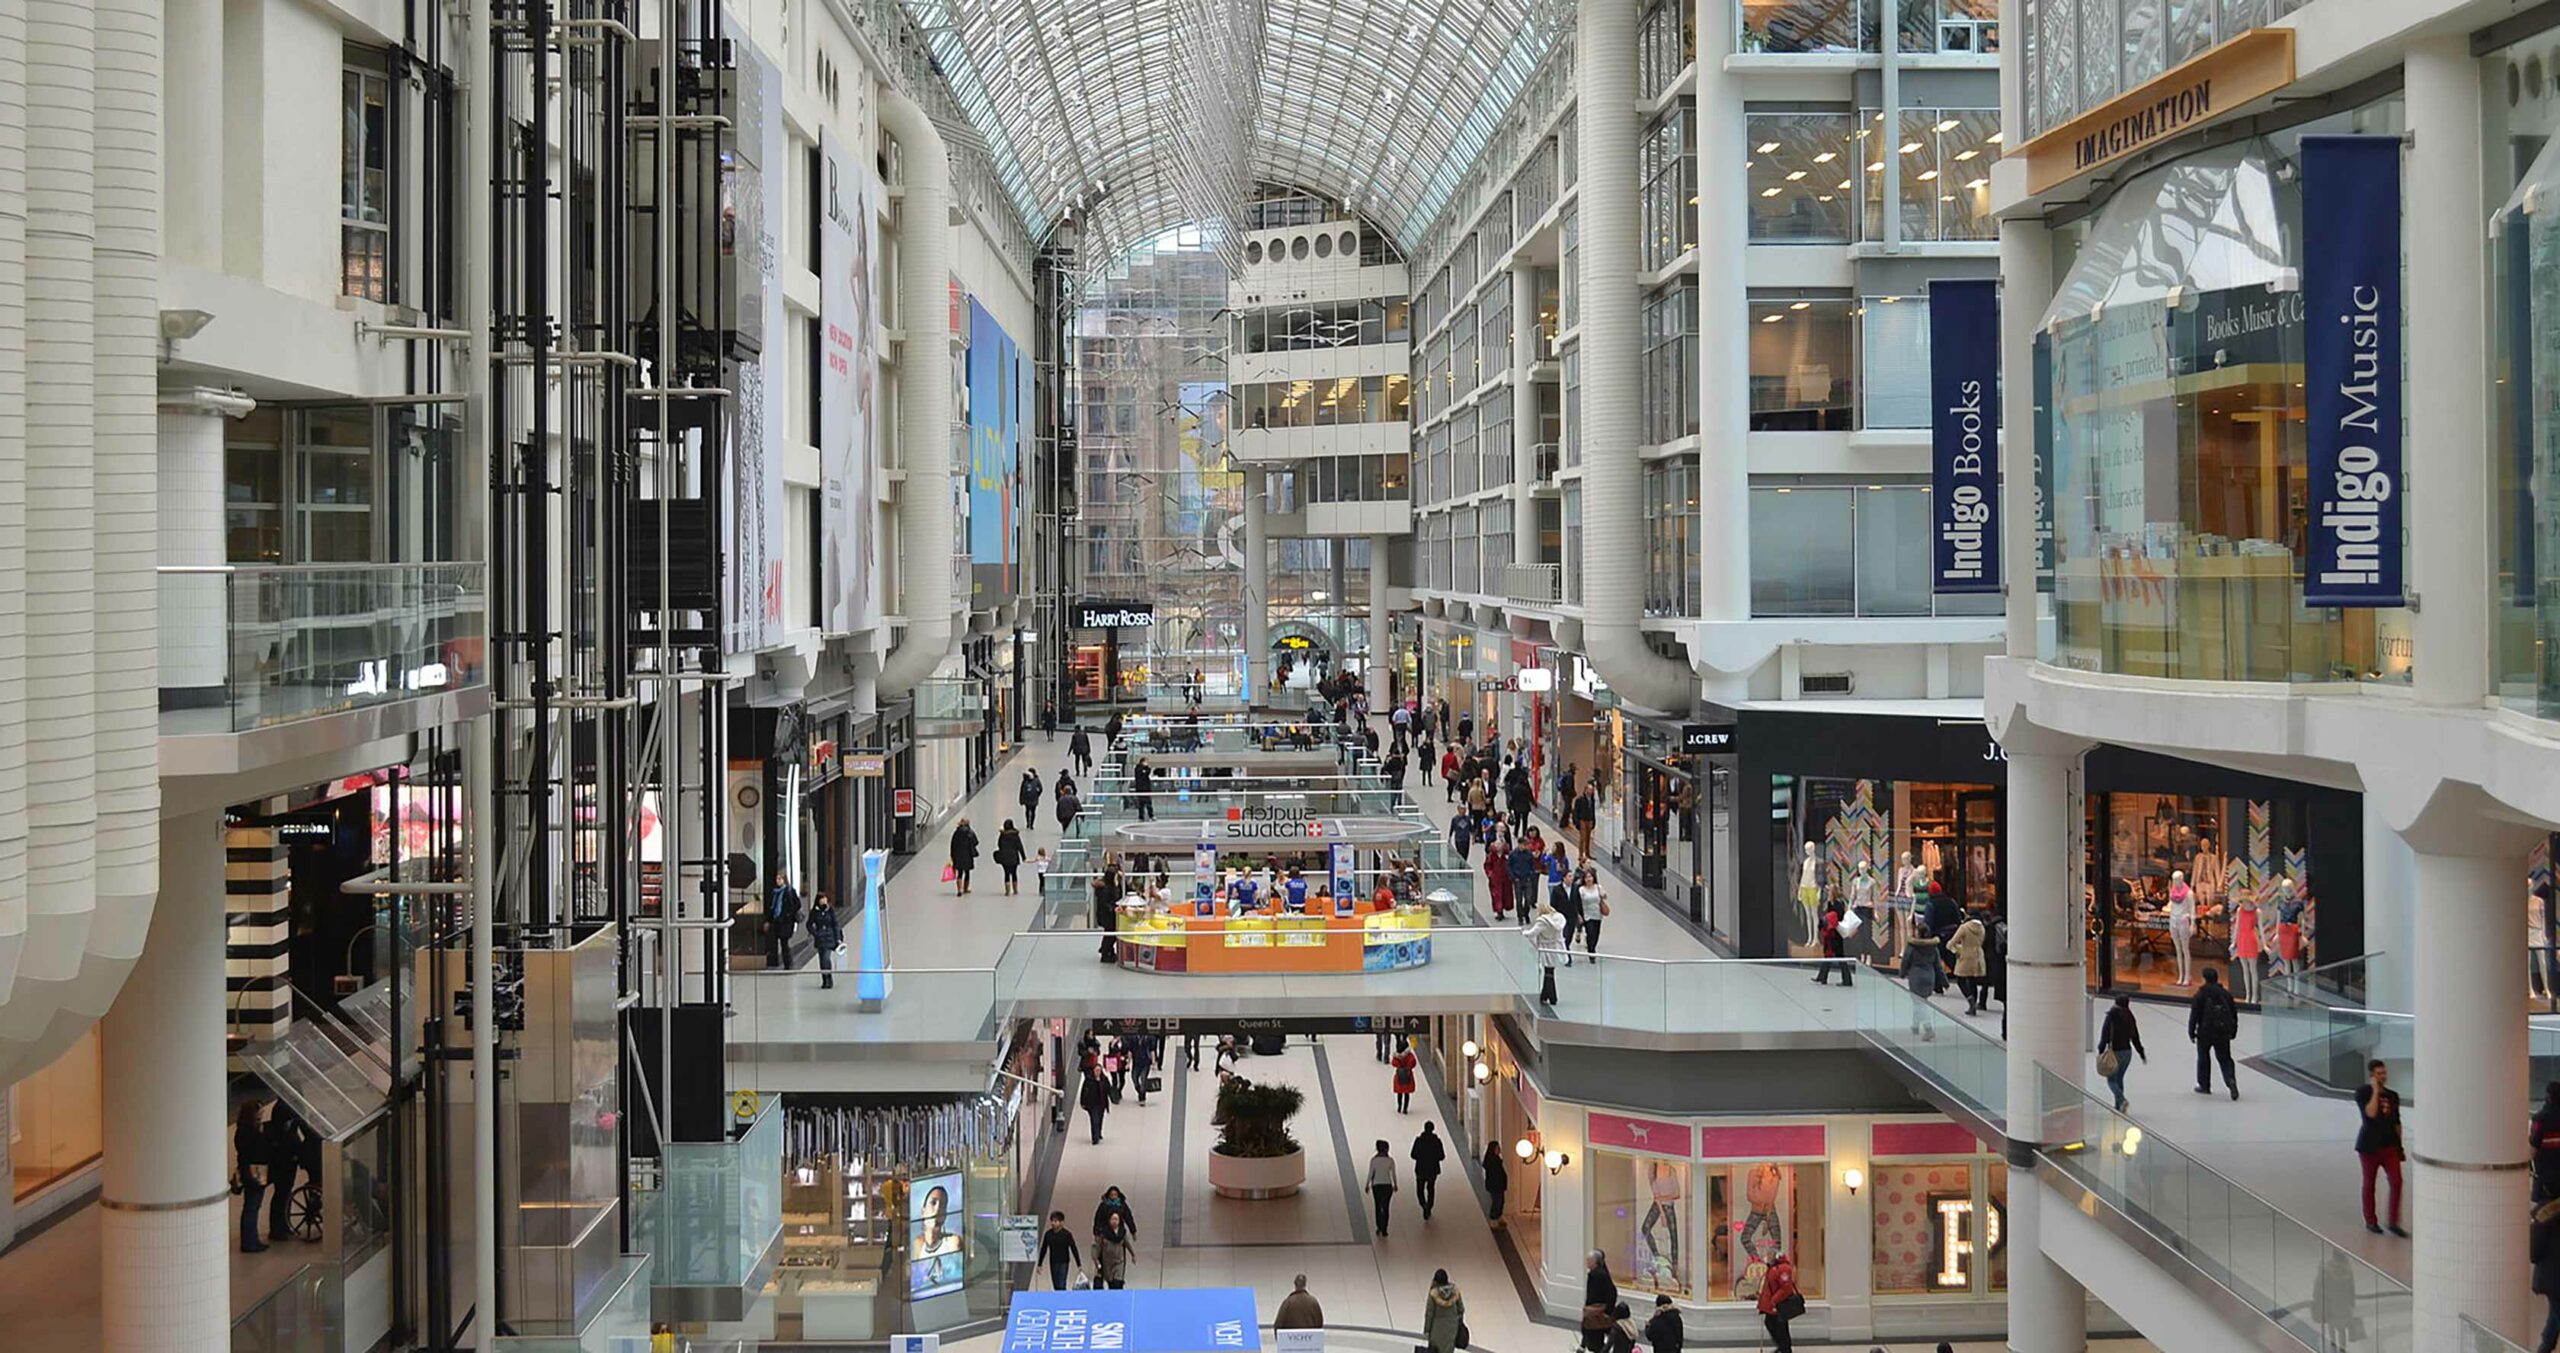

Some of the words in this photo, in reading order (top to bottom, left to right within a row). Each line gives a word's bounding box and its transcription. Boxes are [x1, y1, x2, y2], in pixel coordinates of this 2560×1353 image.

[2075, 79, 2211, 169] IMAGINATION
[2207, 308, 2239, 341] Books
[2242, 304, 2275, 333] Music
[2277, 299, 2286, 325] &
[2340, 286, 2378, 433] Music
[1950, 380, 1982, 475] Books
[1943, 485, 1989, 578] Indigo
[2320, 446, 2391, 584] Indigo
[1083, 610, 1119, 627] HARRY
[1120, 609, 1154, 627] ROSEN
[1687, 733, 1729, 745] J.CREW
[283, 824, 330, 834] SEPHORA
[1227, 820, 1307, 838] swatch
[1239, 1019, 1270, 1029] Queen
[1012, 1309, 1050, 1350] CENTRE
[1051, 1310, 1088, 1350] HEALTH
[1090, 1322, 1125, 1350] SKIN
[1215, 1320, 1243, 1347] VICHY
